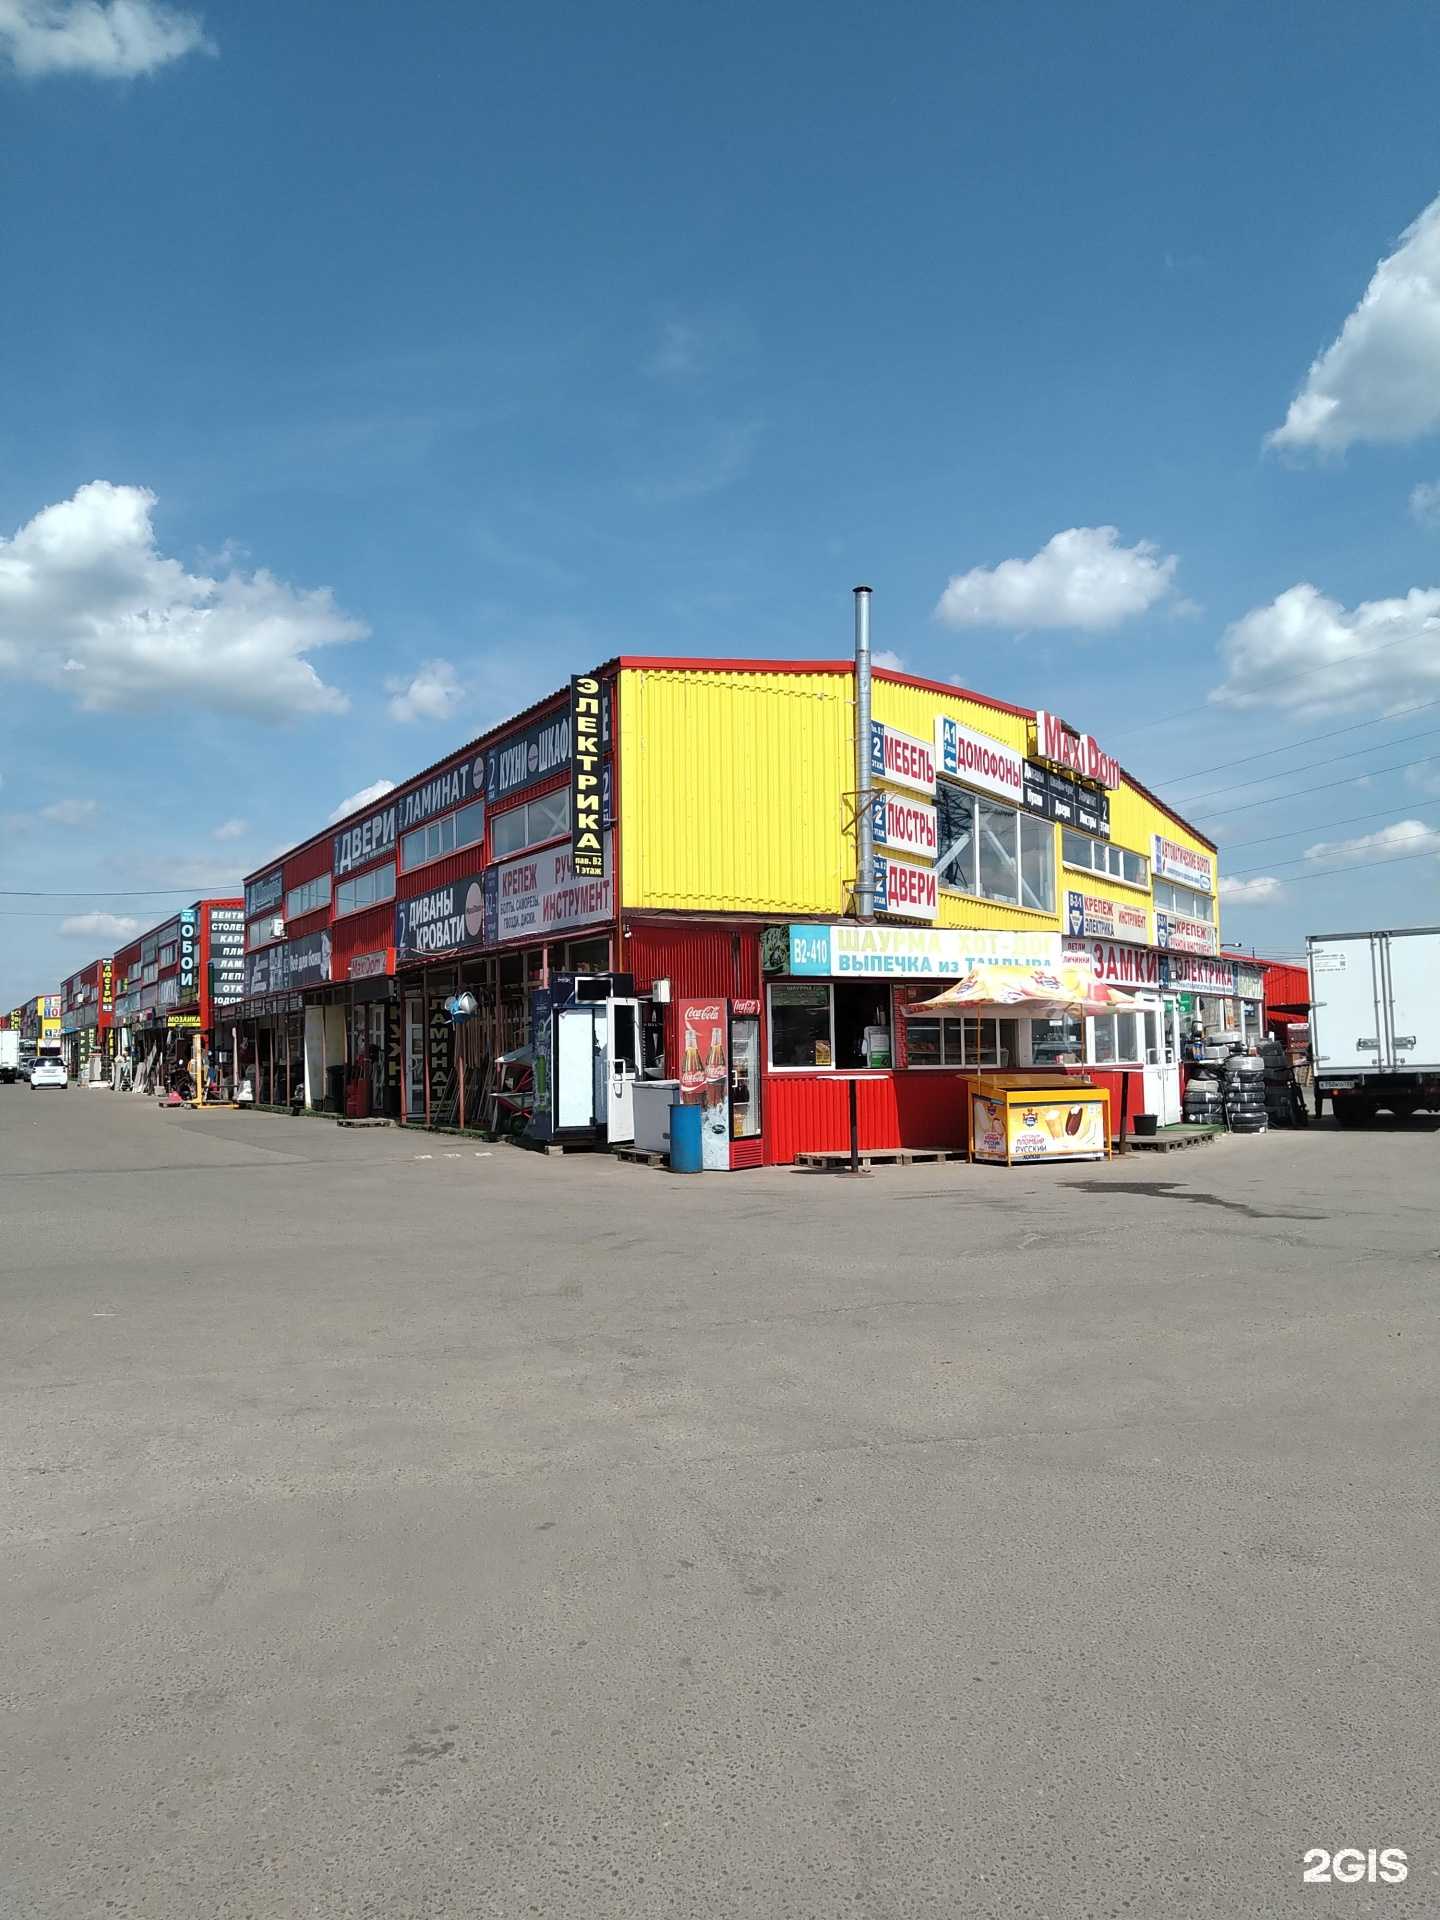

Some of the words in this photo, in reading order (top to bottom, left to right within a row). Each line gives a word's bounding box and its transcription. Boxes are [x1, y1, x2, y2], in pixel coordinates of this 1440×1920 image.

[575, 678, 601, 849] ЭЛЕКТРИКА
[873, 737, 881, 757] 2
[884, 735, 934, 784] МЕБЕЛЬ
[958, 737, 1021, 789] ДОМОФОНЫ
[488, 758, 496, 790] 2
[500, 741, 527, 790] КУХНИ
[404, 764, 469, 827] ЛАМИНАТ
[875, 804, 883, 825] 2
[888, 803, 936, 847] ЛЮСТРЫ
[340, 807, 395, 875] ДВЕРИ
[575, 857, 591, 865] пав.
[575, 866, 580, 874] 1
[581, 867, 602, 875] этаж
[502, 863, 537, 897] КРЕПЕЖ
[888, 866, 936, 908] ДВЕРИ
[409, 887, 454, 932] ДИВАНЫ
[542, 879, 610, 922] ИНСТРУМЕНТ
[1084, 895, 1114, 917] КРЕПЕЖ
[399, 911, 406, 947] 2
[416, 914, 465, 951] КРОВАТИ
[837, 929, 942, 953] ШАУРМА
[1085, 917, 1115, 937] ЭЛЕКТРИКА
[1175, 919, 1207, 939] КРЕПЕЖ
[181, 924, 194, 986] ОБОИ
[838, 954, 932, 972] ВЫПЕЧКА
[939, 961, 959, 972] из
[1063, 955, 1090, 964] ЛИЧИНКИ
[1067, 942, 1086, 951] ПЕТЛИ
[1093, 943, 1158, 983] ЗАМКИ
[1176, 957, 1232, 986] ЭЛЕКТРИКА
[685, 1005, 720, 1020] Coca-Cola
